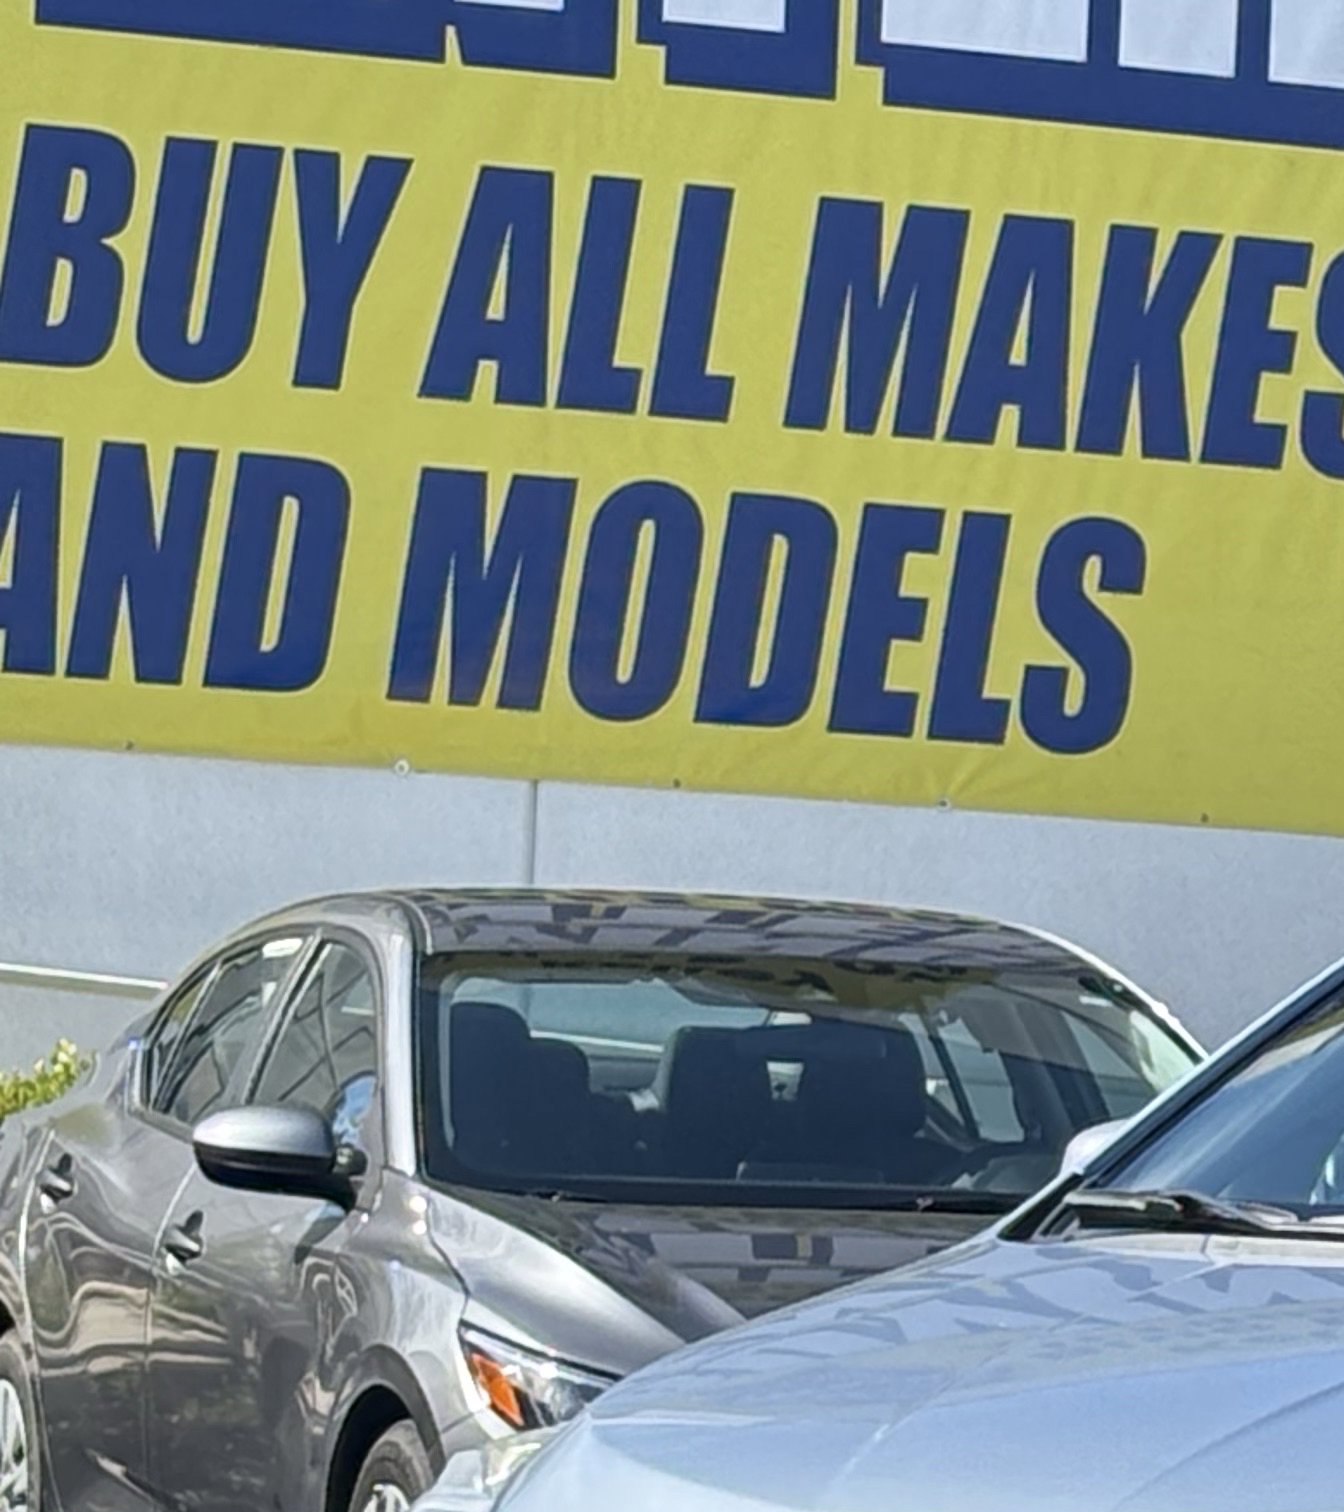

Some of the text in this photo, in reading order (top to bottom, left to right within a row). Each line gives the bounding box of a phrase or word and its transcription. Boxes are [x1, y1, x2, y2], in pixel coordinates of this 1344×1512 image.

[0, 124, 412, 391] BUY
[418, 166, 735, 423] ALL
[386, 467, 1146, 755] MODELS
